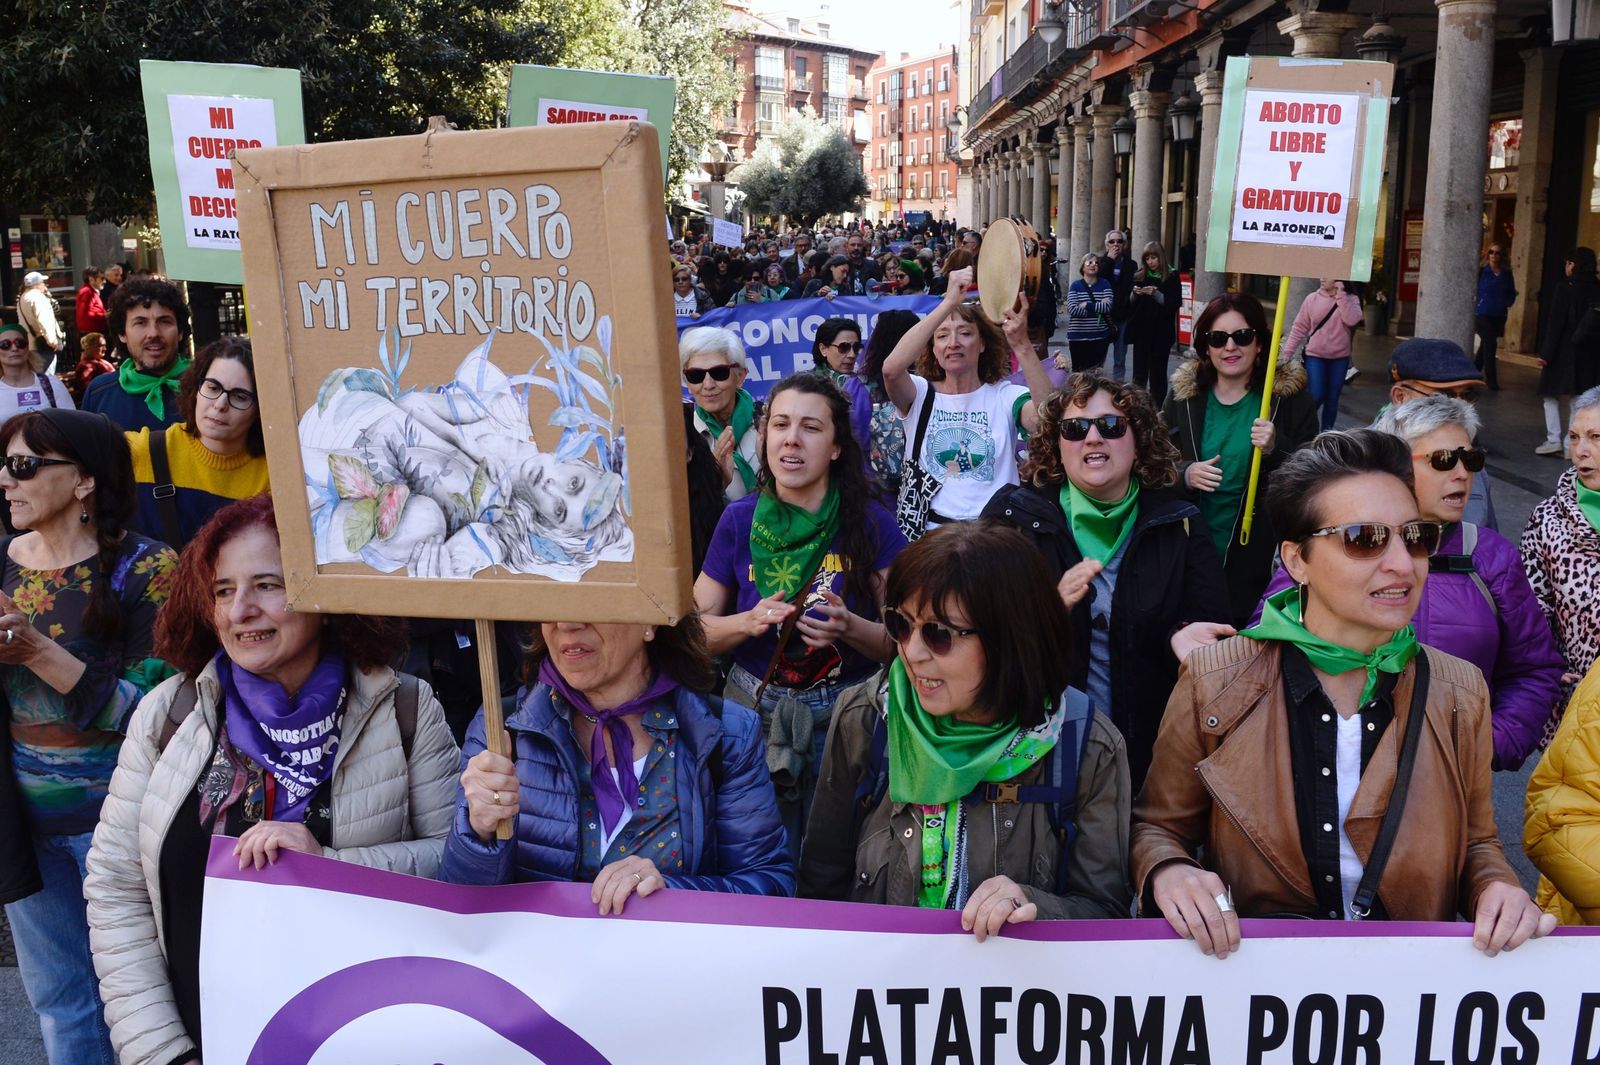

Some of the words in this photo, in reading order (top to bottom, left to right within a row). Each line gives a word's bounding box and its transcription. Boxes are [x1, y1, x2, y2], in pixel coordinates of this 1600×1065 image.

[209, 107, 234, 129] MI
[1259, 101, 1342, 125] ABORTO
[1269, 131, 1327, 154] LIBRE
[216, 168, 234, 189] M
[1289, 161, 1302, 181] Y
[1242, 187, 1342, 214] GRATUITO
[194, 228, 210, 238] LA
[395, 184, 573, 265] CUERPO
[1242, 221, 1259, 231] LA
[365, 259, 596, 342] TERRITORIO
[762, 986, 1212, 1065] PLATAFORMA
[1246, 993, 1385, 1065] POR
[1414, 991, 1546, 1065] LOS
